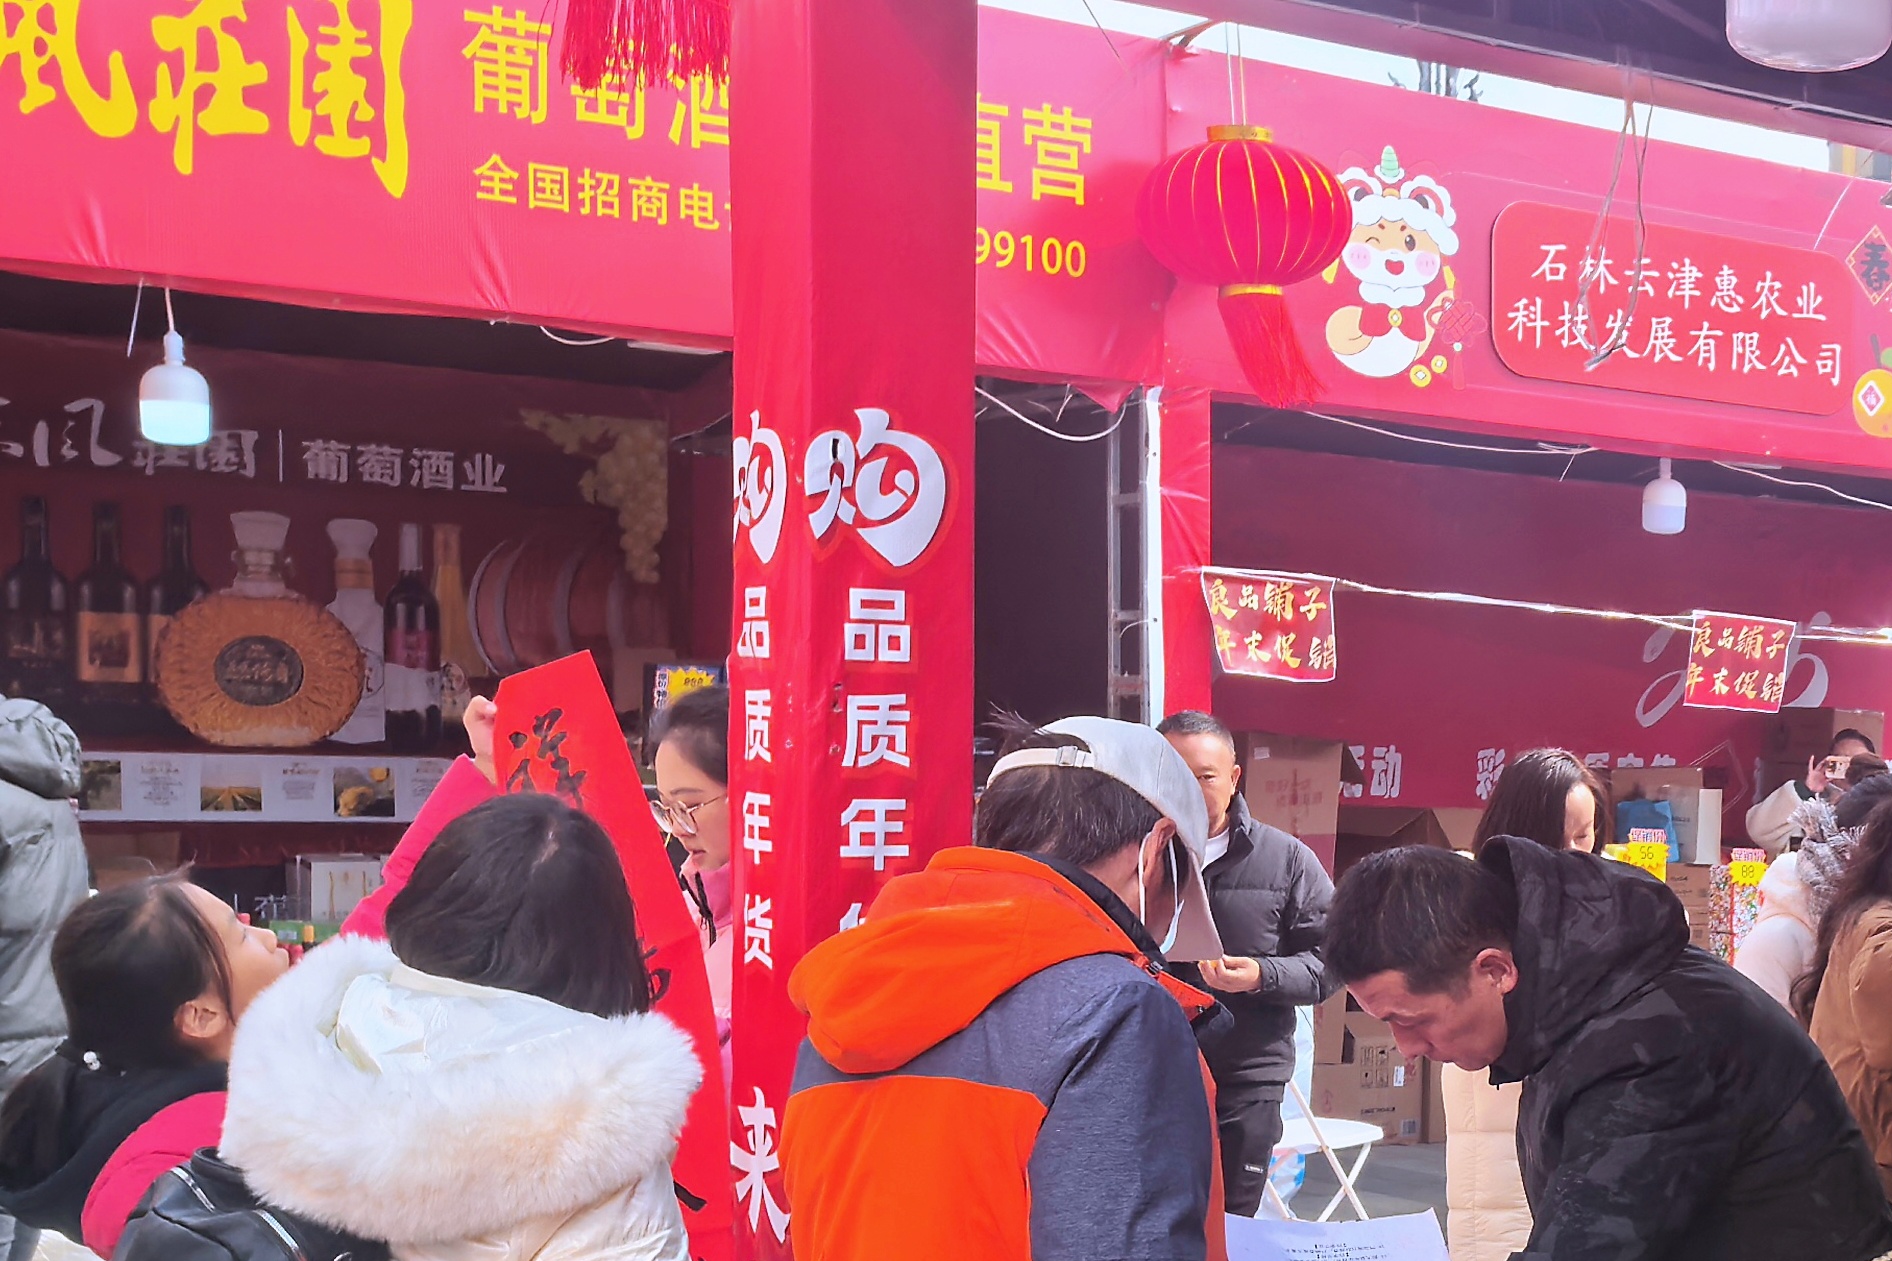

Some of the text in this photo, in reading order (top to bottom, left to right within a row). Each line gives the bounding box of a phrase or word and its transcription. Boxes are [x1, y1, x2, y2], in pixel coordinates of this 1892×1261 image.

[473, 153, 731, 231] 全国招商电
[1531, 244, 1827, 322] 石林云津惠农业
[1507, 296, 1842, 386] 科技发展有限公司
[302, 439, 508, 493] 葡萄酒业
